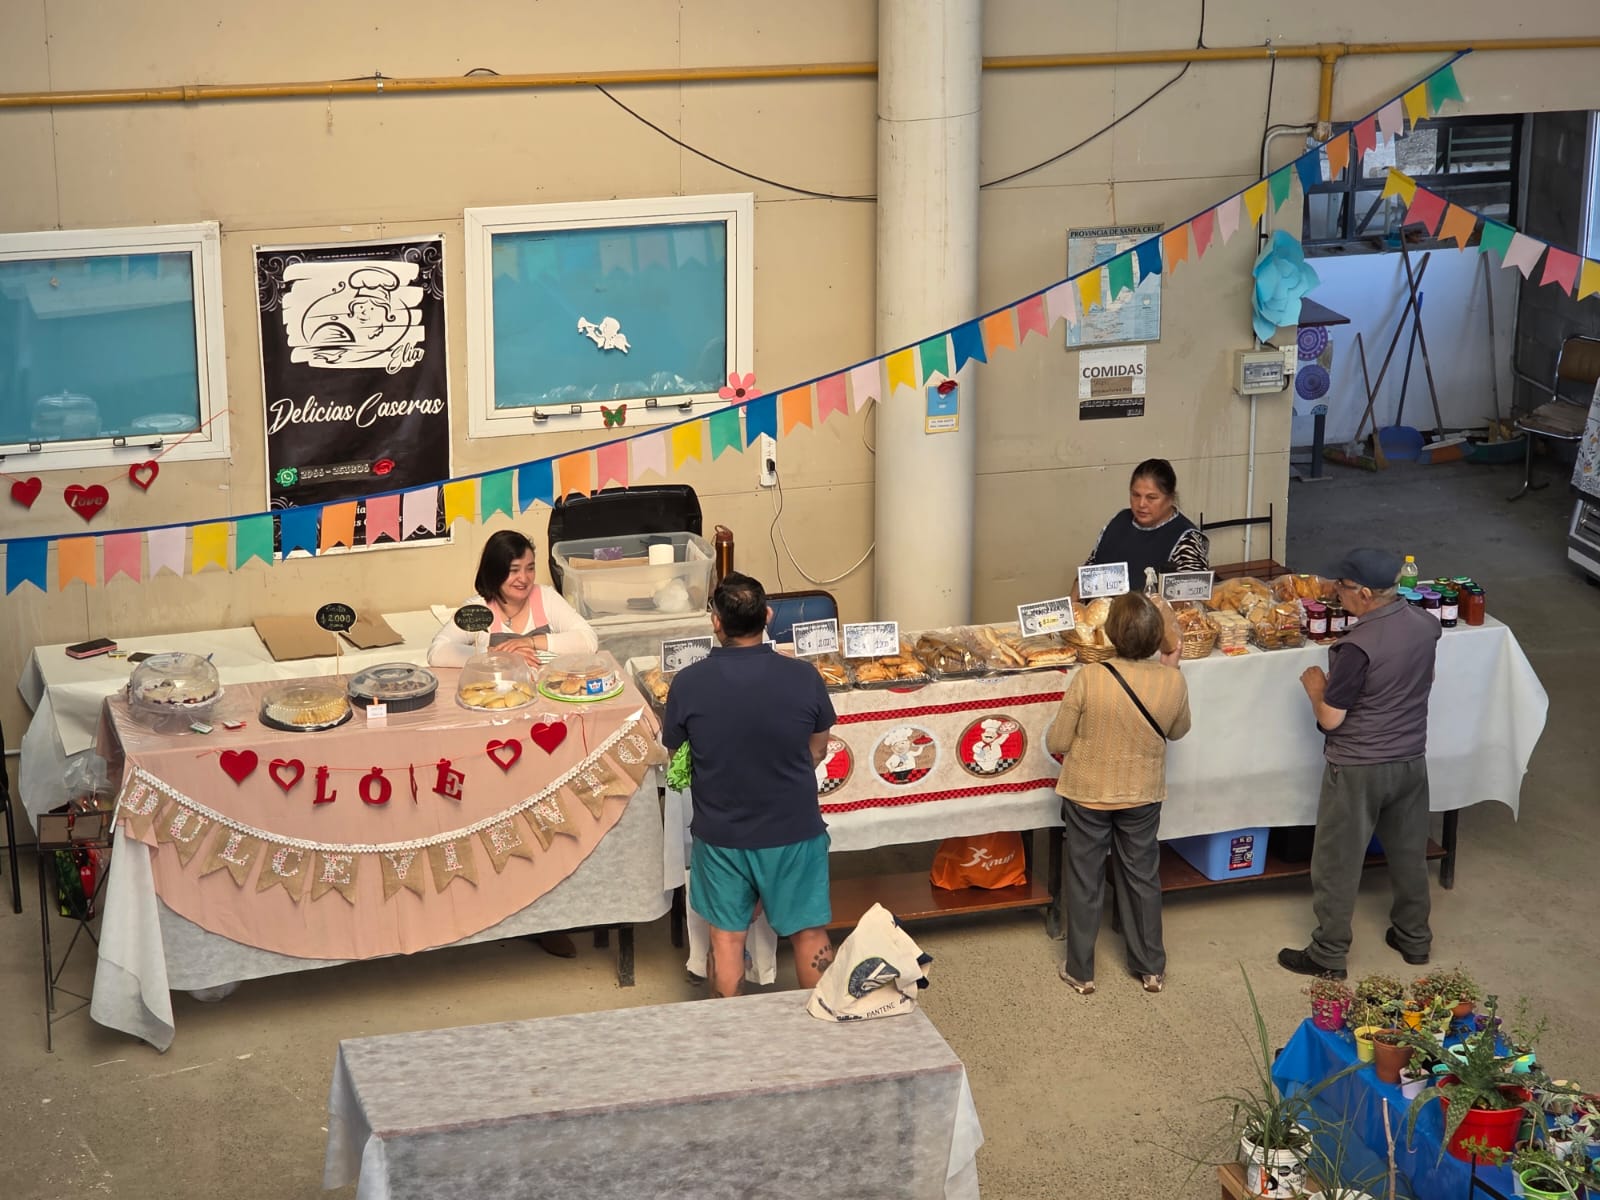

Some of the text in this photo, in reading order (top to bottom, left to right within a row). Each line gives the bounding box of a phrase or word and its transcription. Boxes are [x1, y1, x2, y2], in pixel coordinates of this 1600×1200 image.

[1082, 363, 1144, 379] COMIDAS
[268, 392, 445, 435] Delicias Caseras
[312, 757, 467, 807] LOE
[121, 732, 649, 885] DULCE VIENTO
[866, 1001, 896, 1018] PANTENE
